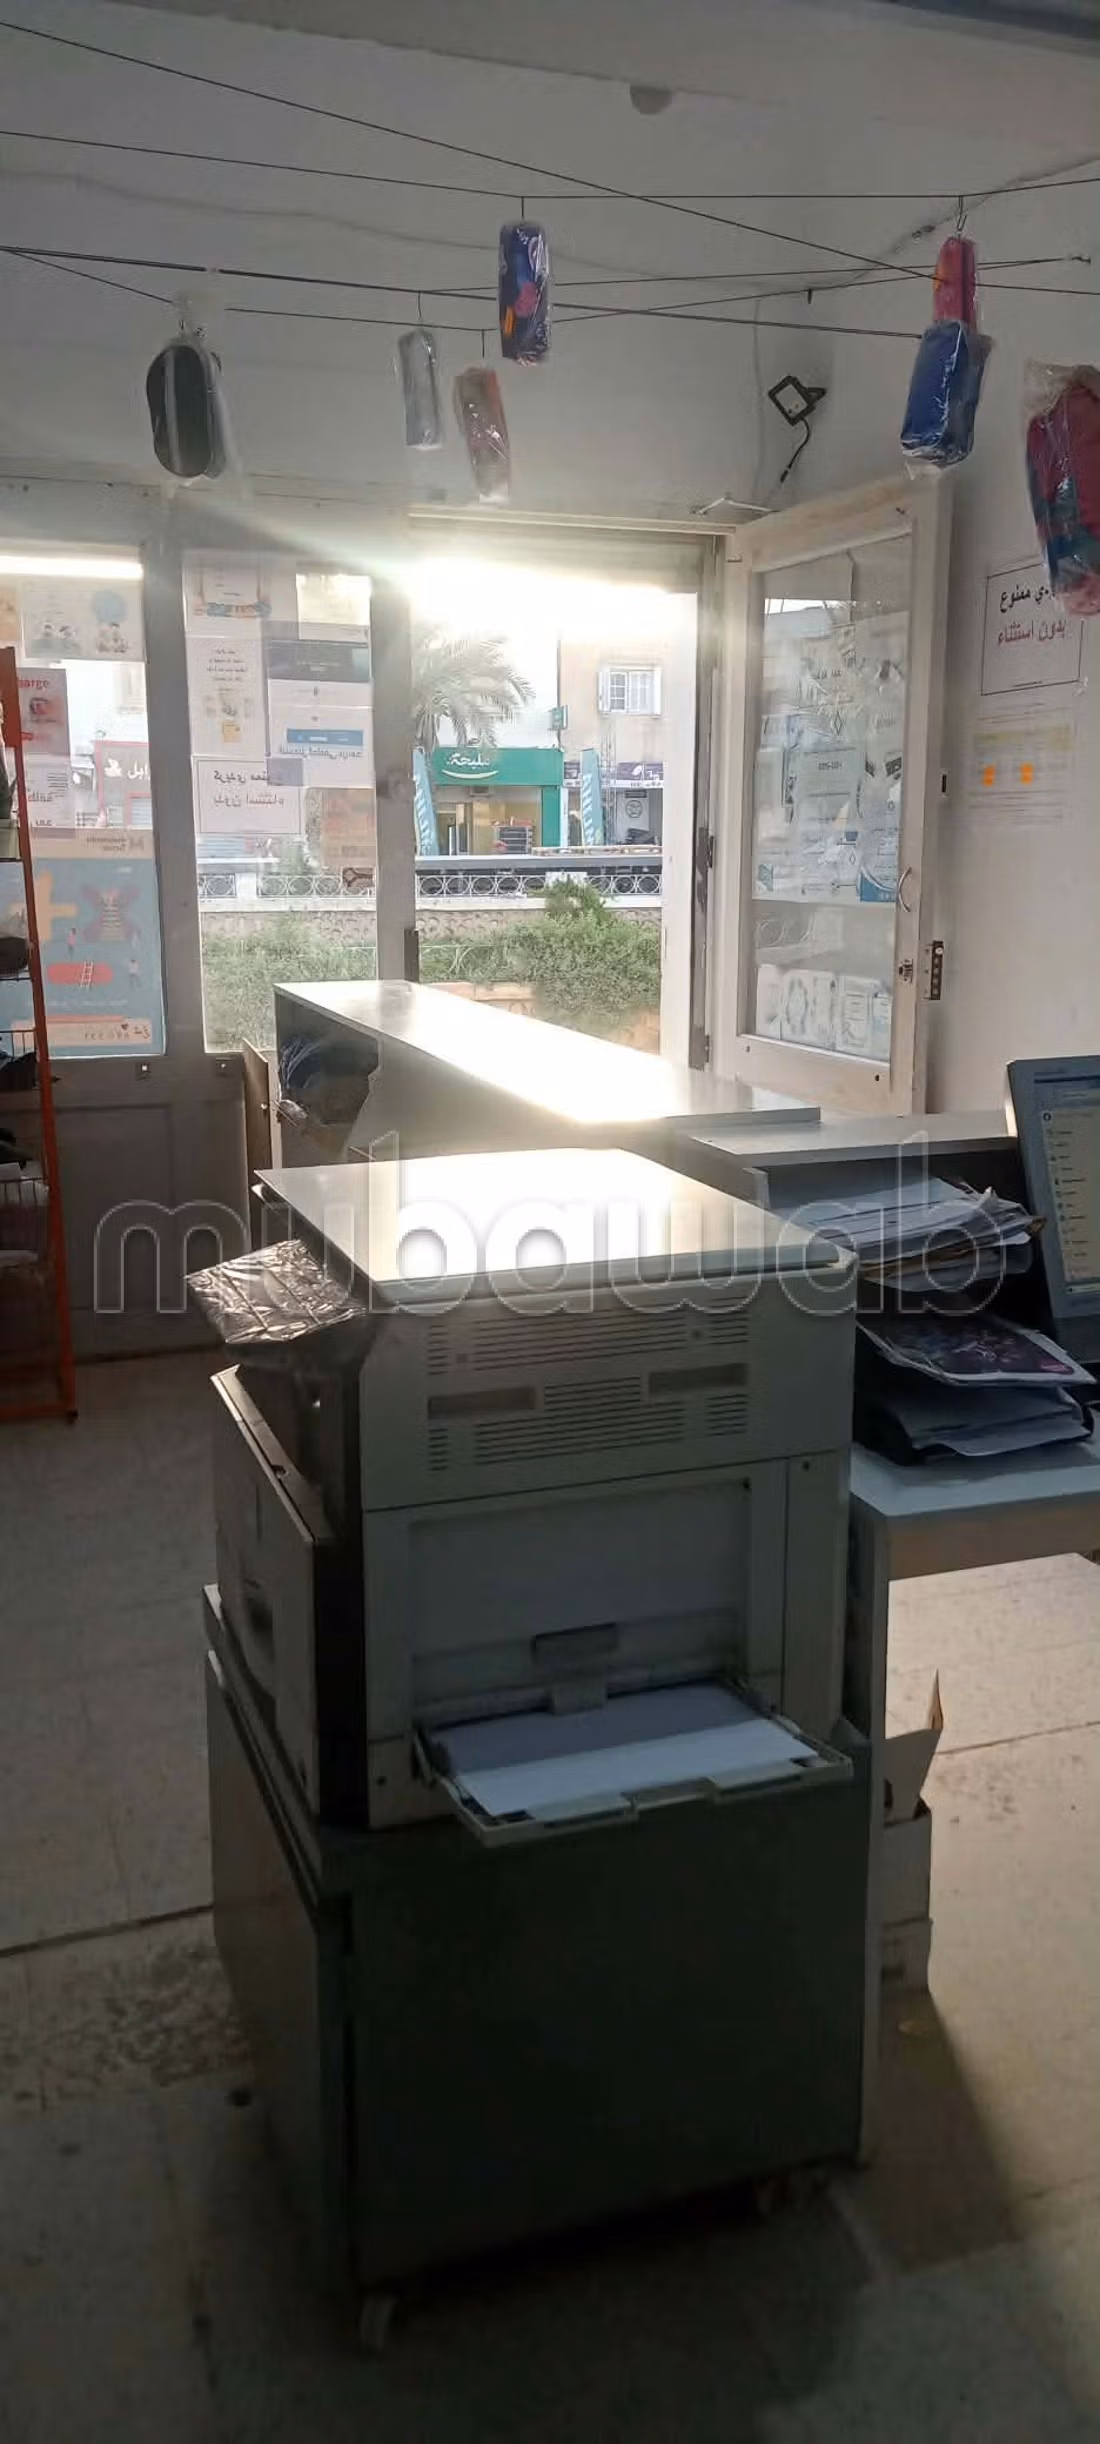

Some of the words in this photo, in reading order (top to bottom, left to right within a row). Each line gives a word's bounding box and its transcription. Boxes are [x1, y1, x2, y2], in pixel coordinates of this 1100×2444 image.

[1000, 584, 1031, 613] ممنوع
[998, 619, 1034, 645] استثناء
[1038, 620, 1067, 642] بدون
